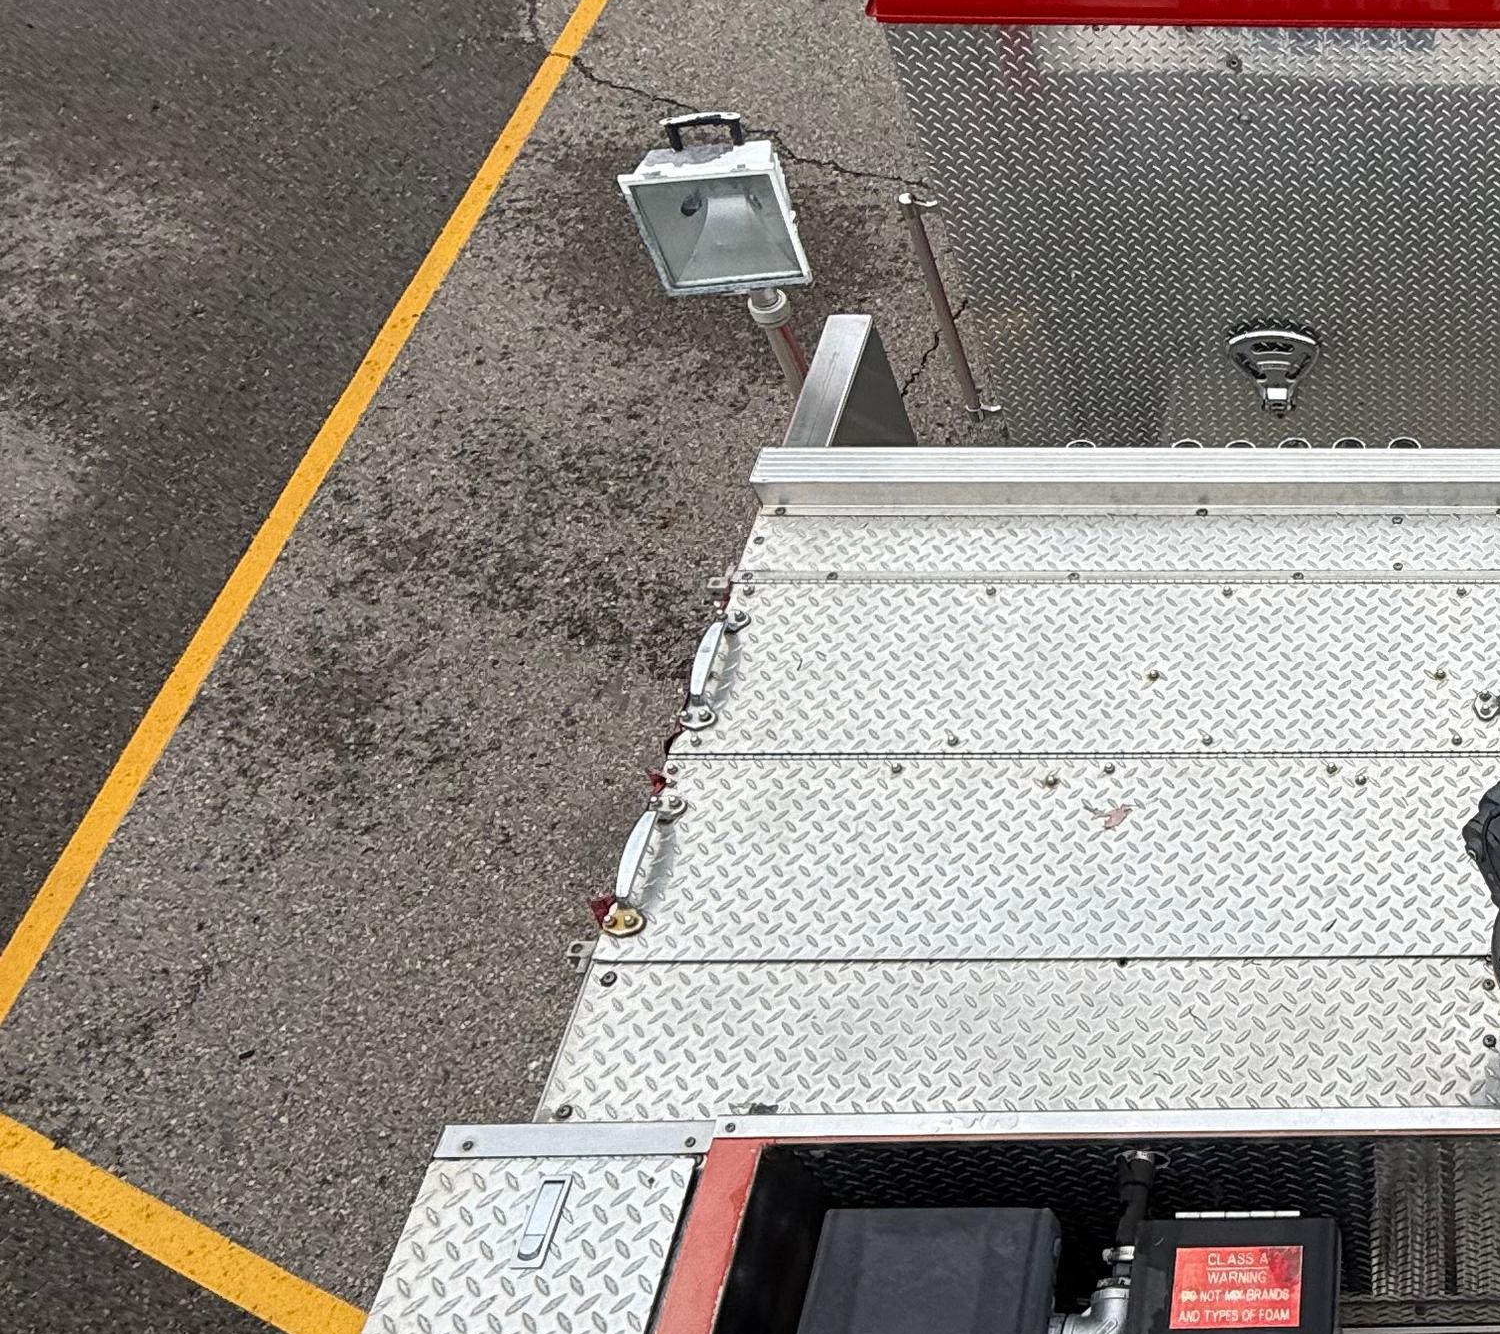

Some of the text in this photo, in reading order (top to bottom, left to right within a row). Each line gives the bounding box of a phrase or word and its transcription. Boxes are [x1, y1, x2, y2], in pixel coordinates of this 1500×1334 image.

[1207, 1252, 1269, 1266] CLASS A
[1207, 1270, 1268, 1284] WARNING
[1199, 1289, 1221, 1302] NOT
[1246, 1288, 1290, 1301] BRANDS
[1178, 1308, 1290, 1323] AND TYPES OF FOAM
